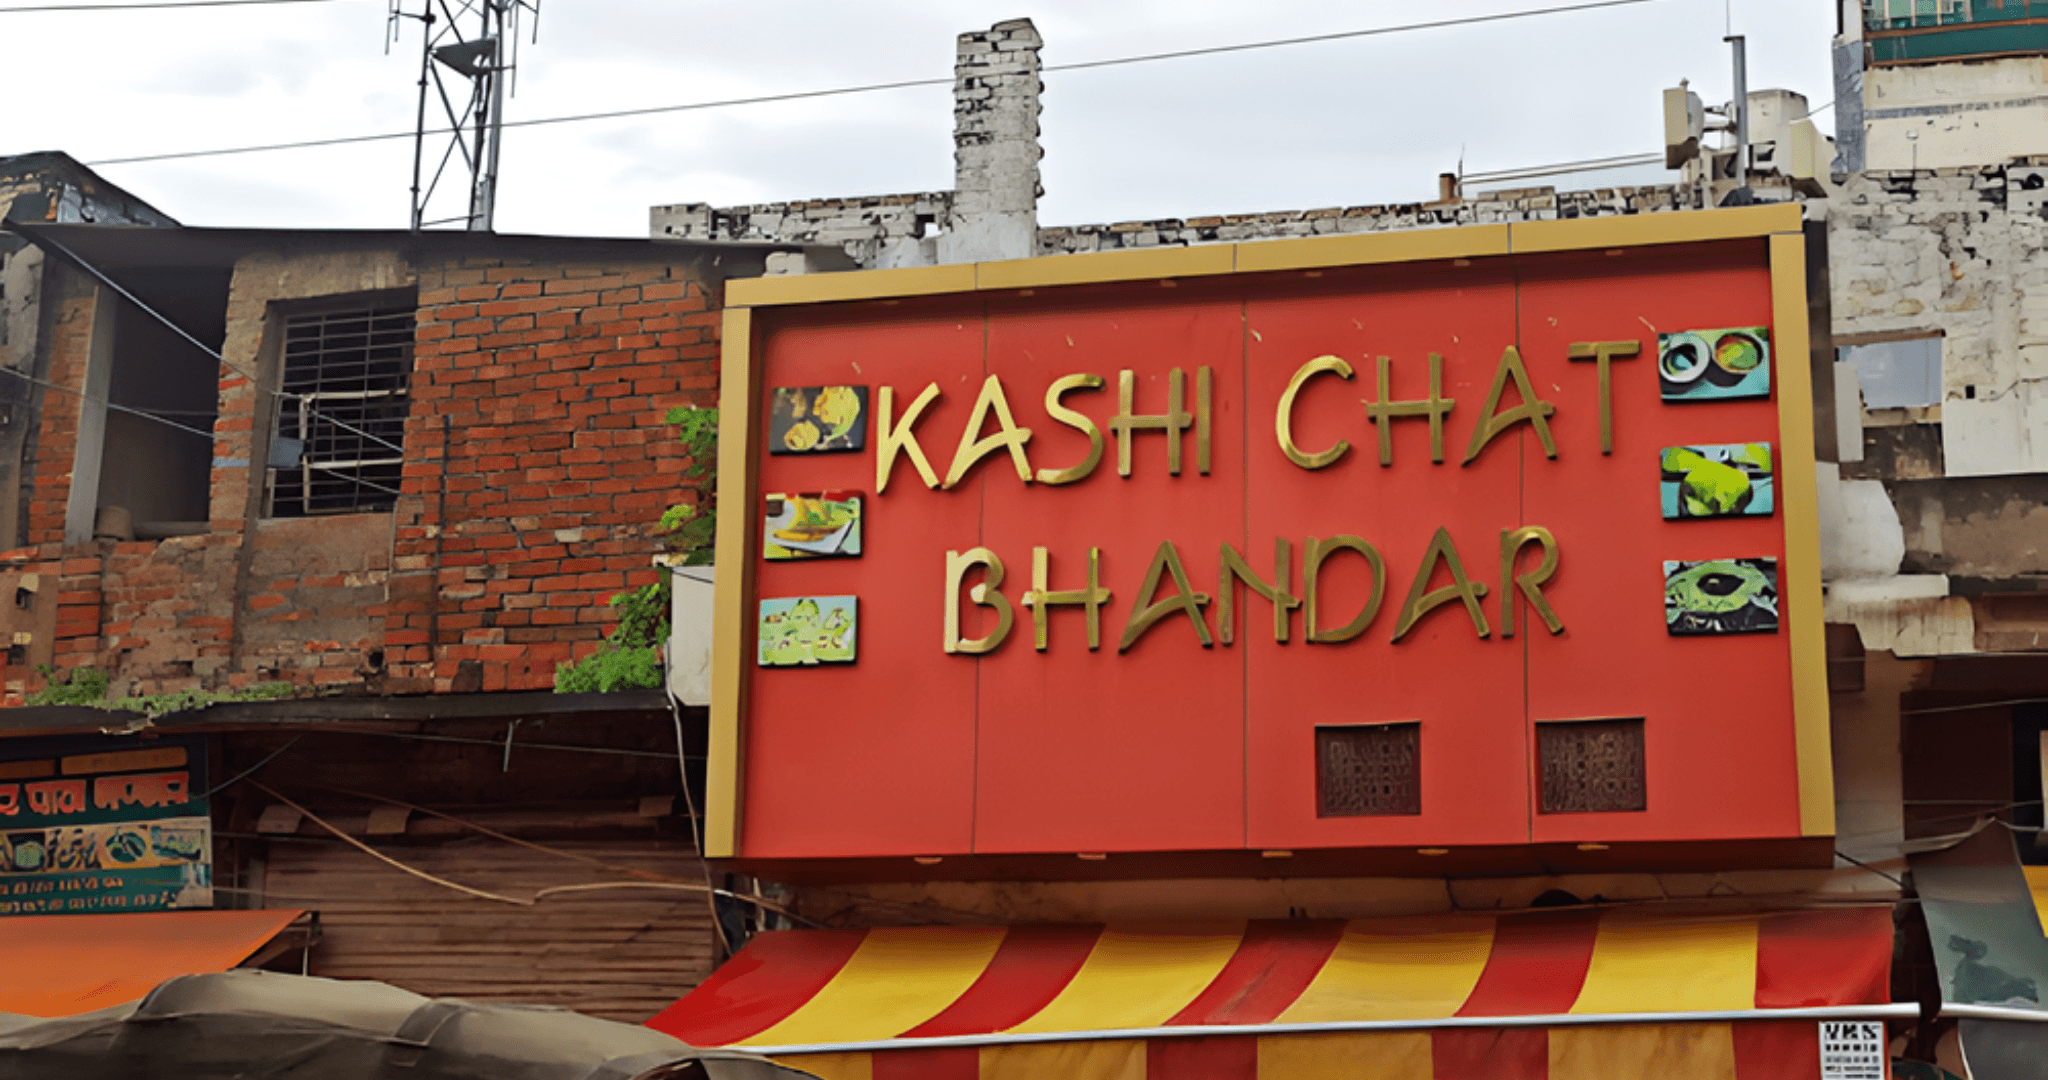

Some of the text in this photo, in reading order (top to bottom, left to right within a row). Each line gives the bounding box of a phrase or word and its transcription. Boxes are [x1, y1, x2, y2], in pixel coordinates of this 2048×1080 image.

[876, 340, 1641, 495] KASHI CHAT
[944, 526, 1565, 654] BHANDAR
